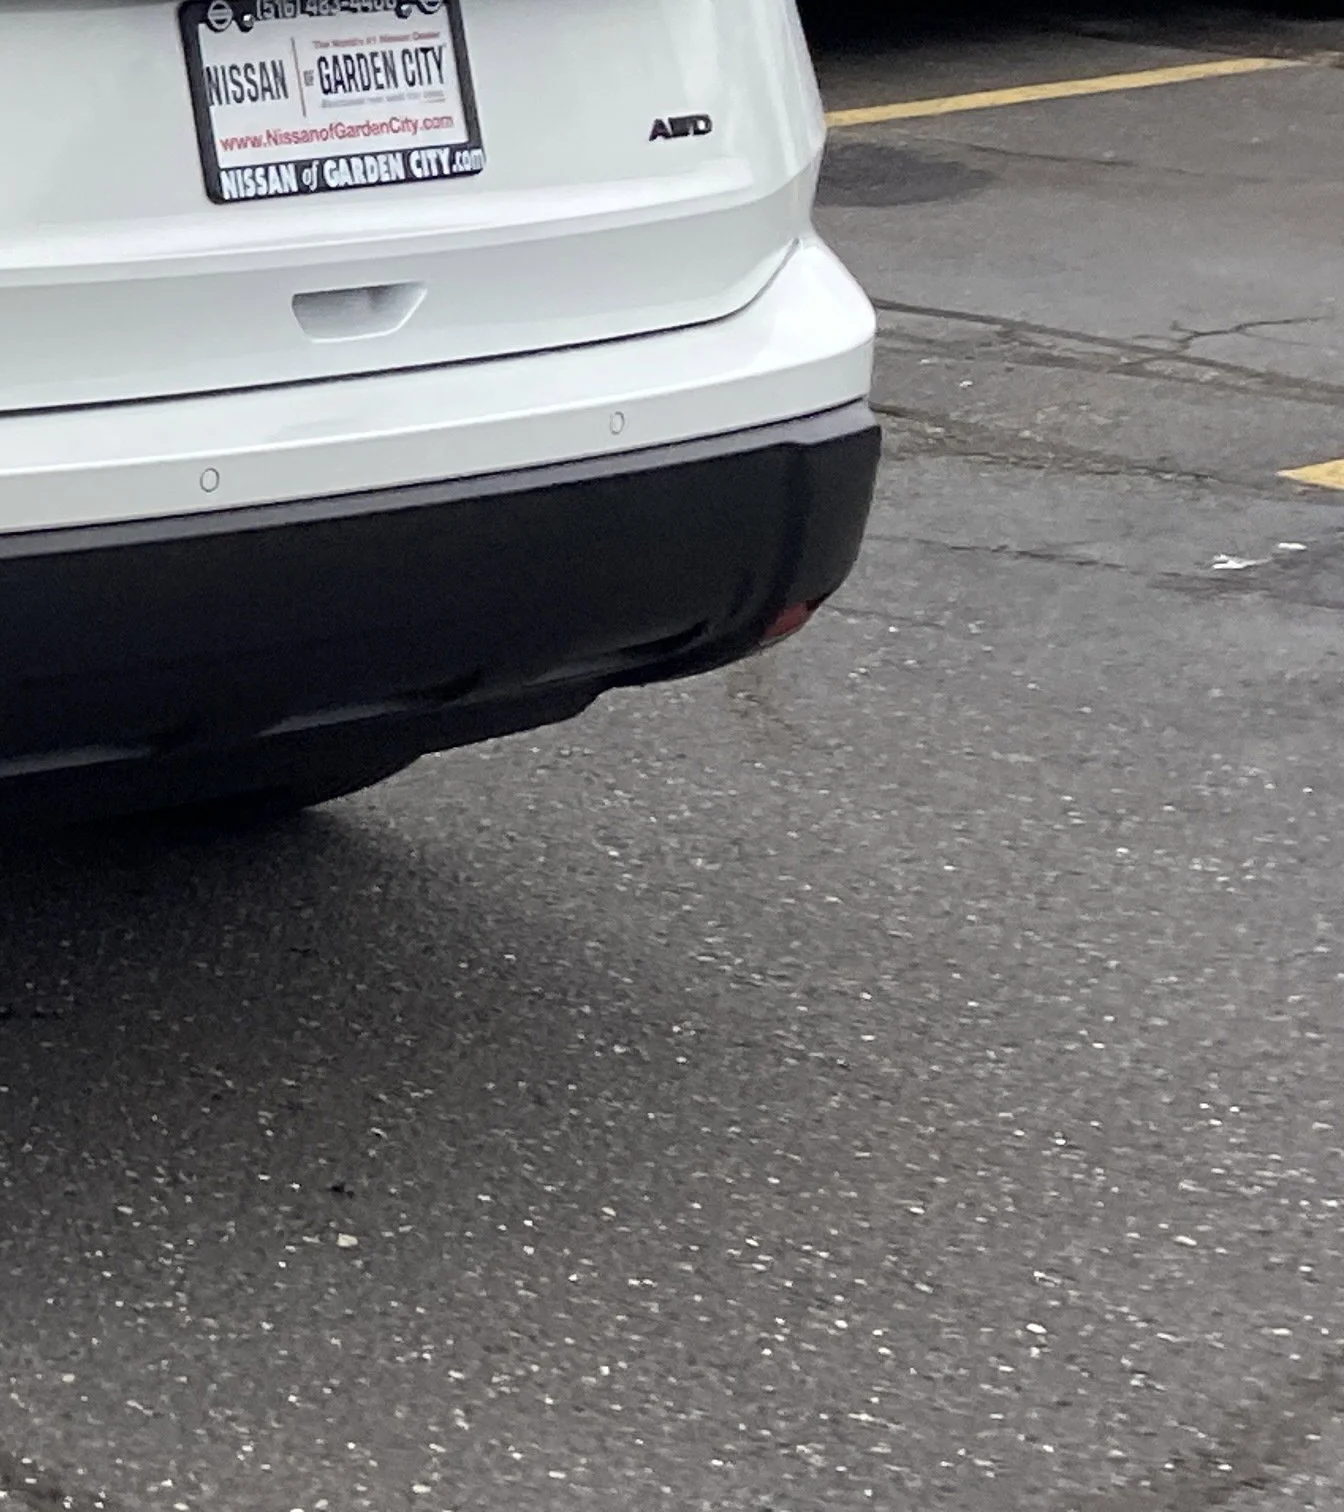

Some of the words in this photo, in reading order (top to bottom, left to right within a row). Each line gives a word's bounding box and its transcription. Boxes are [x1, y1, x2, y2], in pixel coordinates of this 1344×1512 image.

[204, 59, 290, 107] NISSAN
[317, 48, 400, 96] GARDEN
[402, 44, 446, 88] CITY
[219, 114, 454, 152] www.NissanofGardenCity.com
[219, 163, 299, 201] NISSAN
[302, 160, 320, 191] of
[323, 152, 406, 189] GARDEN
